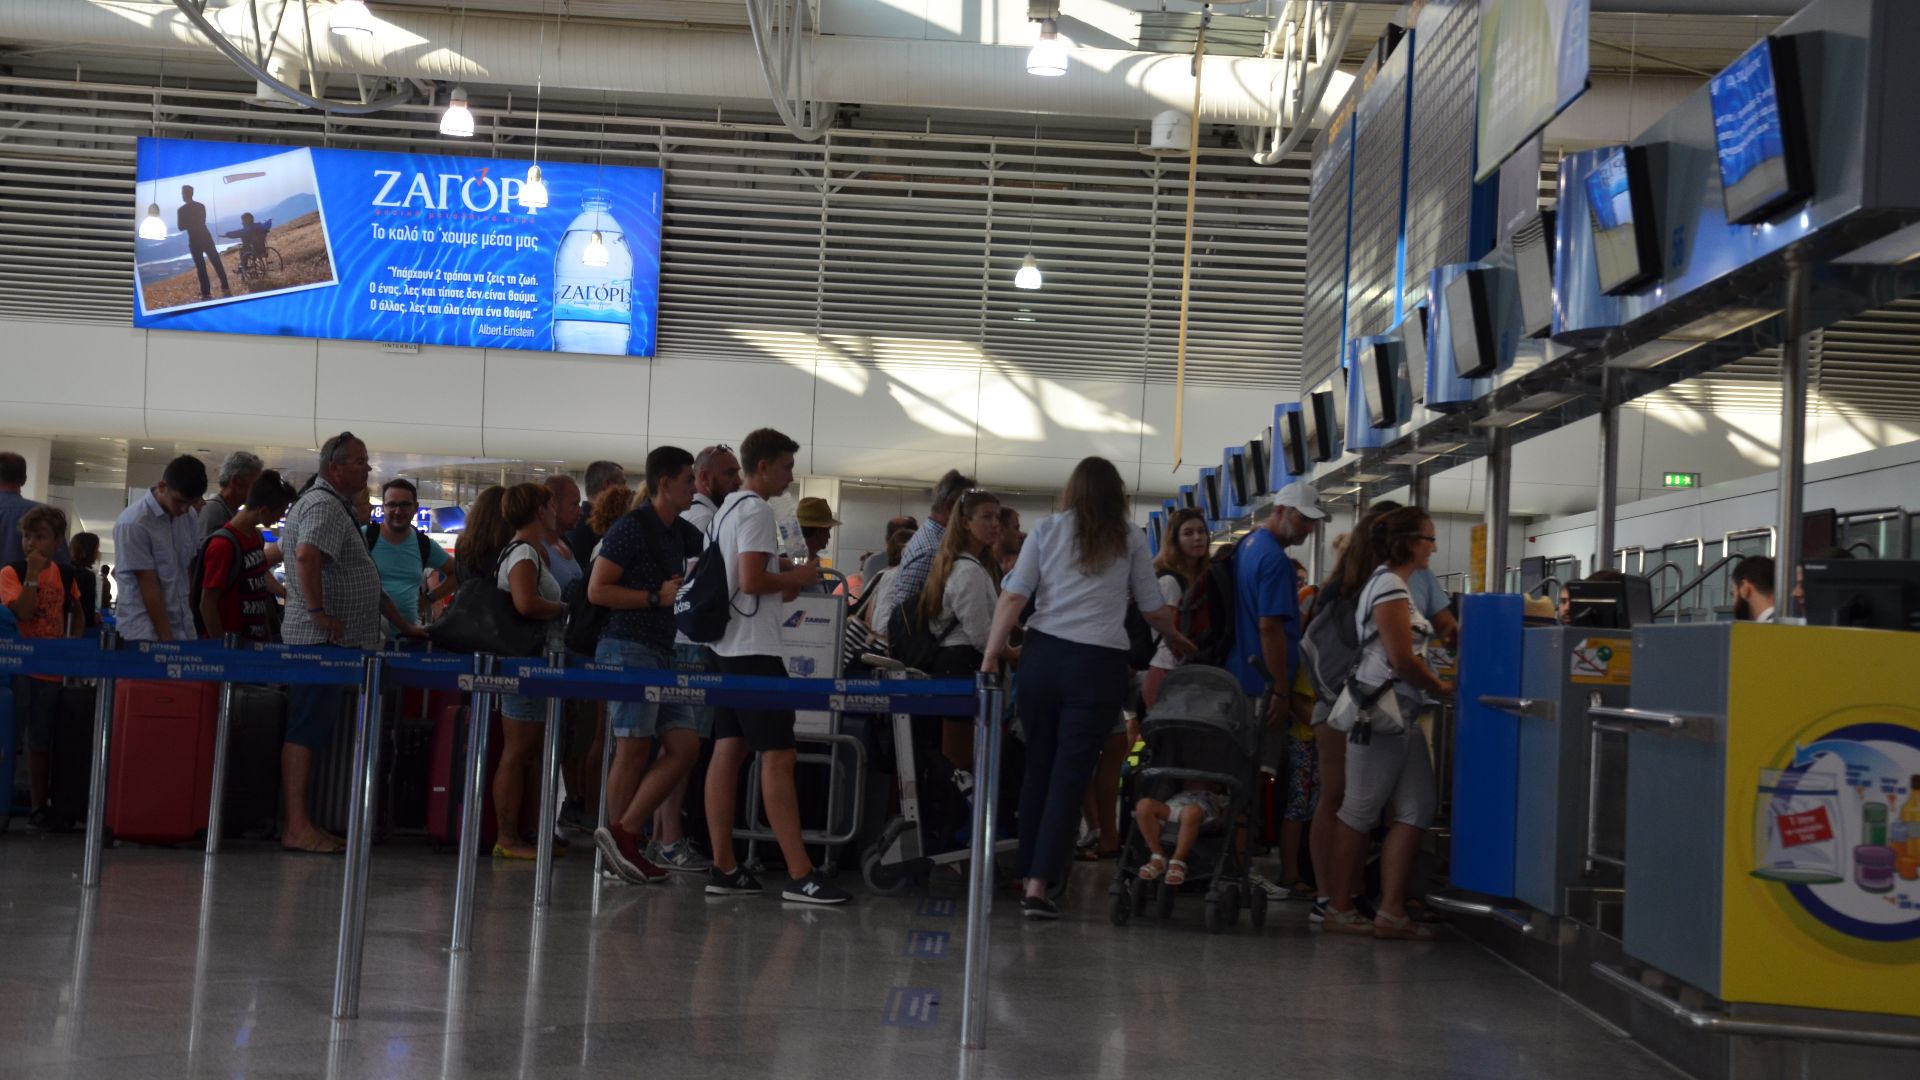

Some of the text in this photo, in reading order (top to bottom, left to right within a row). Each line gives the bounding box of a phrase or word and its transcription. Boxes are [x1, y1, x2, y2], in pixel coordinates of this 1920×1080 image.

[371, 168, 538, 215] ΖΑΓΌΡ
[371, 223, 385, 239] Το
[389, 225, 418, 241] καλό
[422, 230, 435, 242] το
[481, 231, 512, 249] μέσα
[515, 236, 539, 251] μας
[435, 269, 441, 280] 2
[443, 269, 471, 284] τρόποι
[473, 273, 485, 283] να
[486, 271, 504, 286] ζεις
[507, 275, 517, 286] τη
[518, 273, 539, 286] ζωή.
[369, 282, 376, 293] Ο
[403, 284, 420, 297] λες
[421, 287, 436, 296] και
[437, 286, 464, 299] τίποτε
[466, 288, 482, 299] δεν
[484, 288, 506, 300] είναι
[508, 289, 538, 305] θαύμα.
[370, 299, 377, 310] Ο
[409, 301, 425, 315] λες
[427, 304, 441, 314] και
[443, 304, 460, 314] όλα
[461, 305, 484, 316] είναι
[485, 306, 502, 317] ένα
[478, 323, 535, 338] Albert Einstein
[150, 643, 180, 651] ATHENS
[167, 654, 203, 662] ATHENS
[182, 664, 225, 672] ATHENS
[334, 660, 362, 668] ATHEN
[594, 664, 624, 672] ATHENS
[531, 666, 565, 675] ATHENS
[474, 675, 520, 686] ATHENS
[661, 687, 706, 697] ATHENS
[845, 695, 890, 704] ATHENS
[802, 882, 820, 895] N
